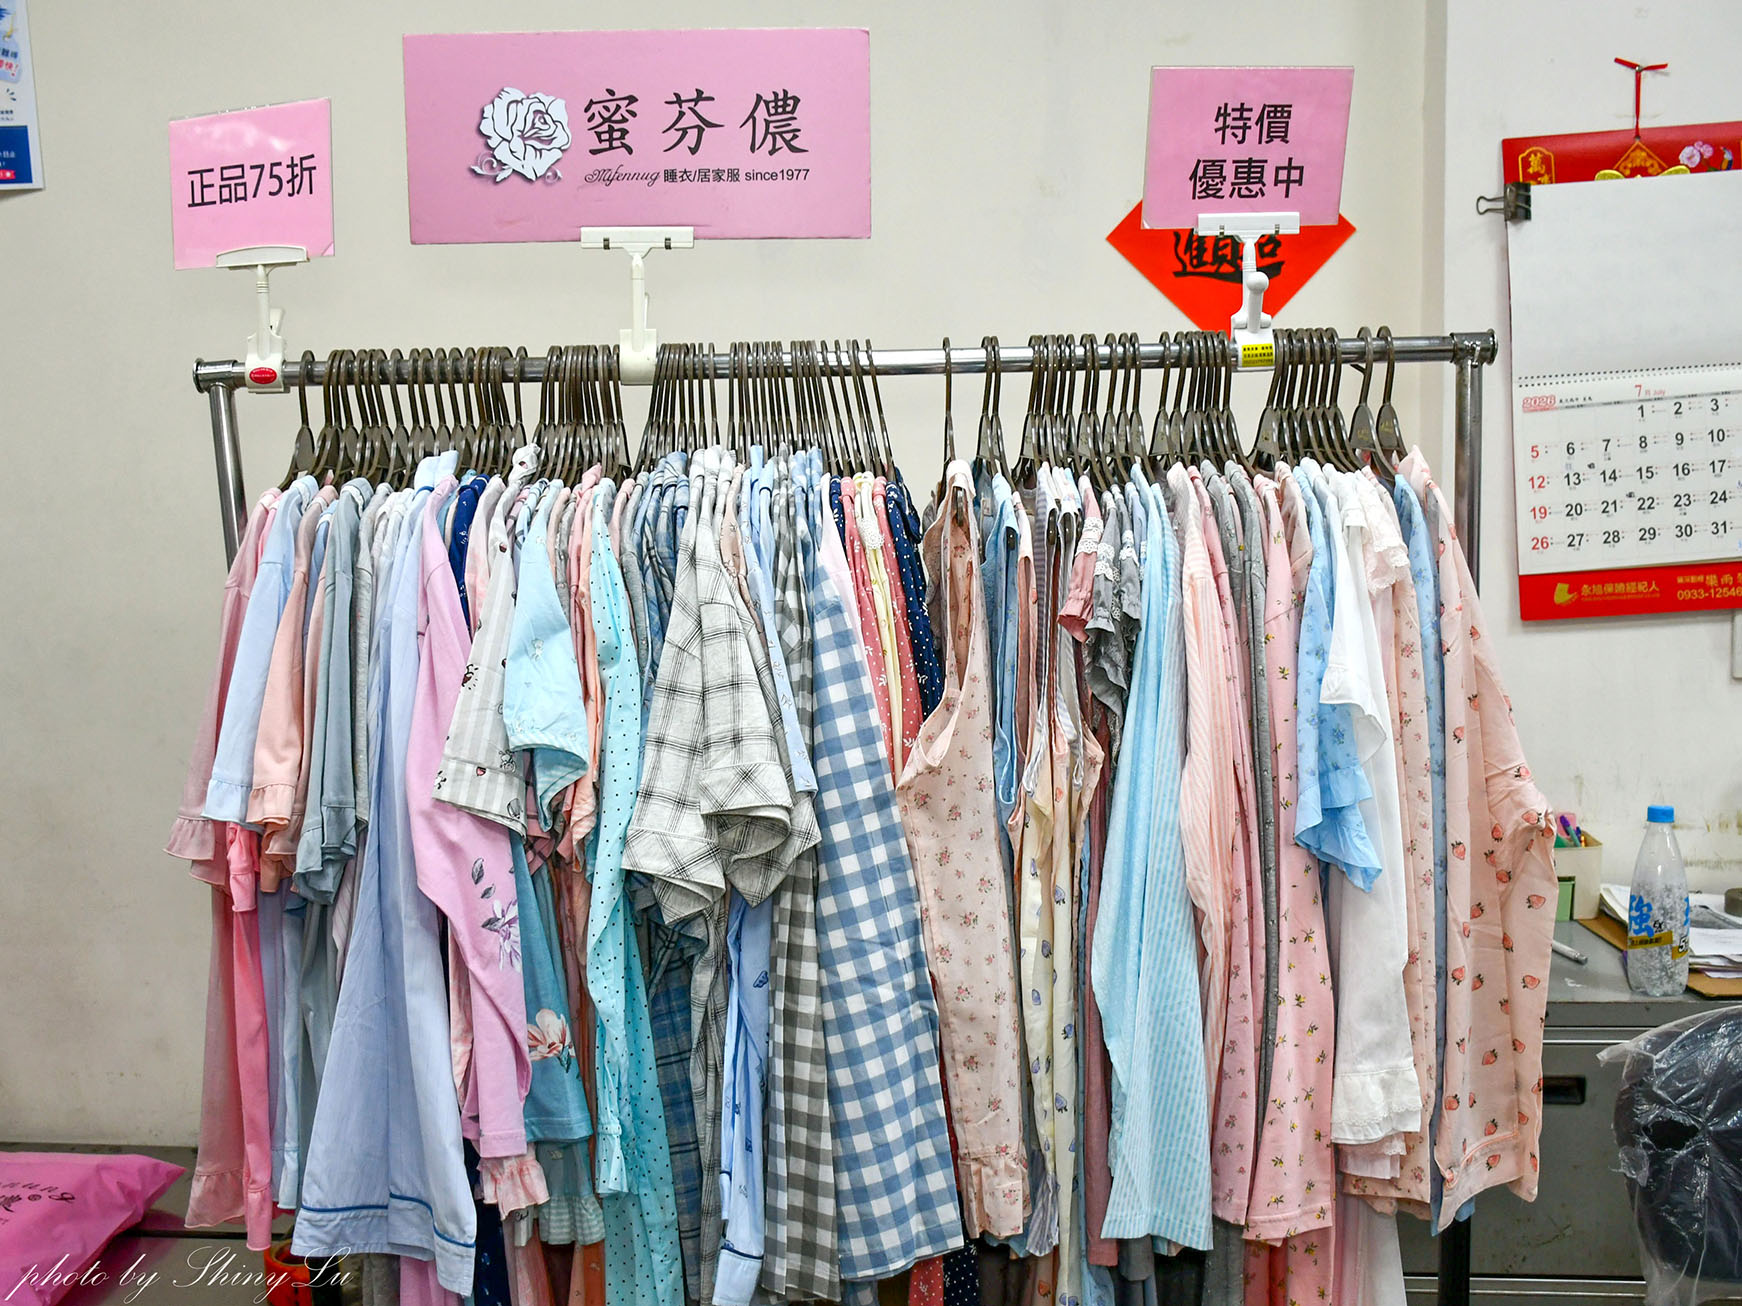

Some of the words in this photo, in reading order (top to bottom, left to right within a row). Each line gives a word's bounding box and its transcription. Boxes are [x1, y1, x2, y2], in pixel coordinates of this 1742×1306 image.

[583, 88, 809, 156] 蜜芬儂
[1214, 102, 1292, 145] 特價
[187, 153, 317, 208] 正品75折
[663, 168, 741, 183] 睡衣/居家服
[744, 168, 810, 182] since1977
[1188, 157, 1305, 200] 優惠中
[1634, 384, 1643, 397] 7
[1637, 404, 1645, 418] 1
[1673, 401, 1683, 415] 2
[1710, 398, 1720, 412] 3
[1531, 445, 1540, 459] 5
[1566, 441, 1576, 456] 6
[1602, 438, 1611, 452] 7
[1638, 435, 1648, 450] 8
[1674, 432, 1685, 446] 9
[1707, 428, 1726, 443] 10
[1528, 475, 1545, 489] 12
[1564, 471, 1582, 486] 13
[1599, 468, 1618, 483] 14
[1636, 465, 1655, 480] 15
[1672, 462, 1691, 477] 16
[1709, 459, 1727, 474] 17
[1530, 505, 1548, 520] 19
[1565, 502, 1583, 517] 20
[1601, 499, 1618, 514] 21
[1637, 496, 1655, 511] 22
[1673, 493, 1692, 508] 23
[1709, 489, 1728, 505] 24
[1531, 536, 1550, 551] 26
[1567, 533, 1585, 548] 27
[1602, 529, 1621, 545] 28
[1638, 526, 1657, 542] 29
[1675, 523, 1693, 539] 30
[1711, 520, 1727, 535] 31
